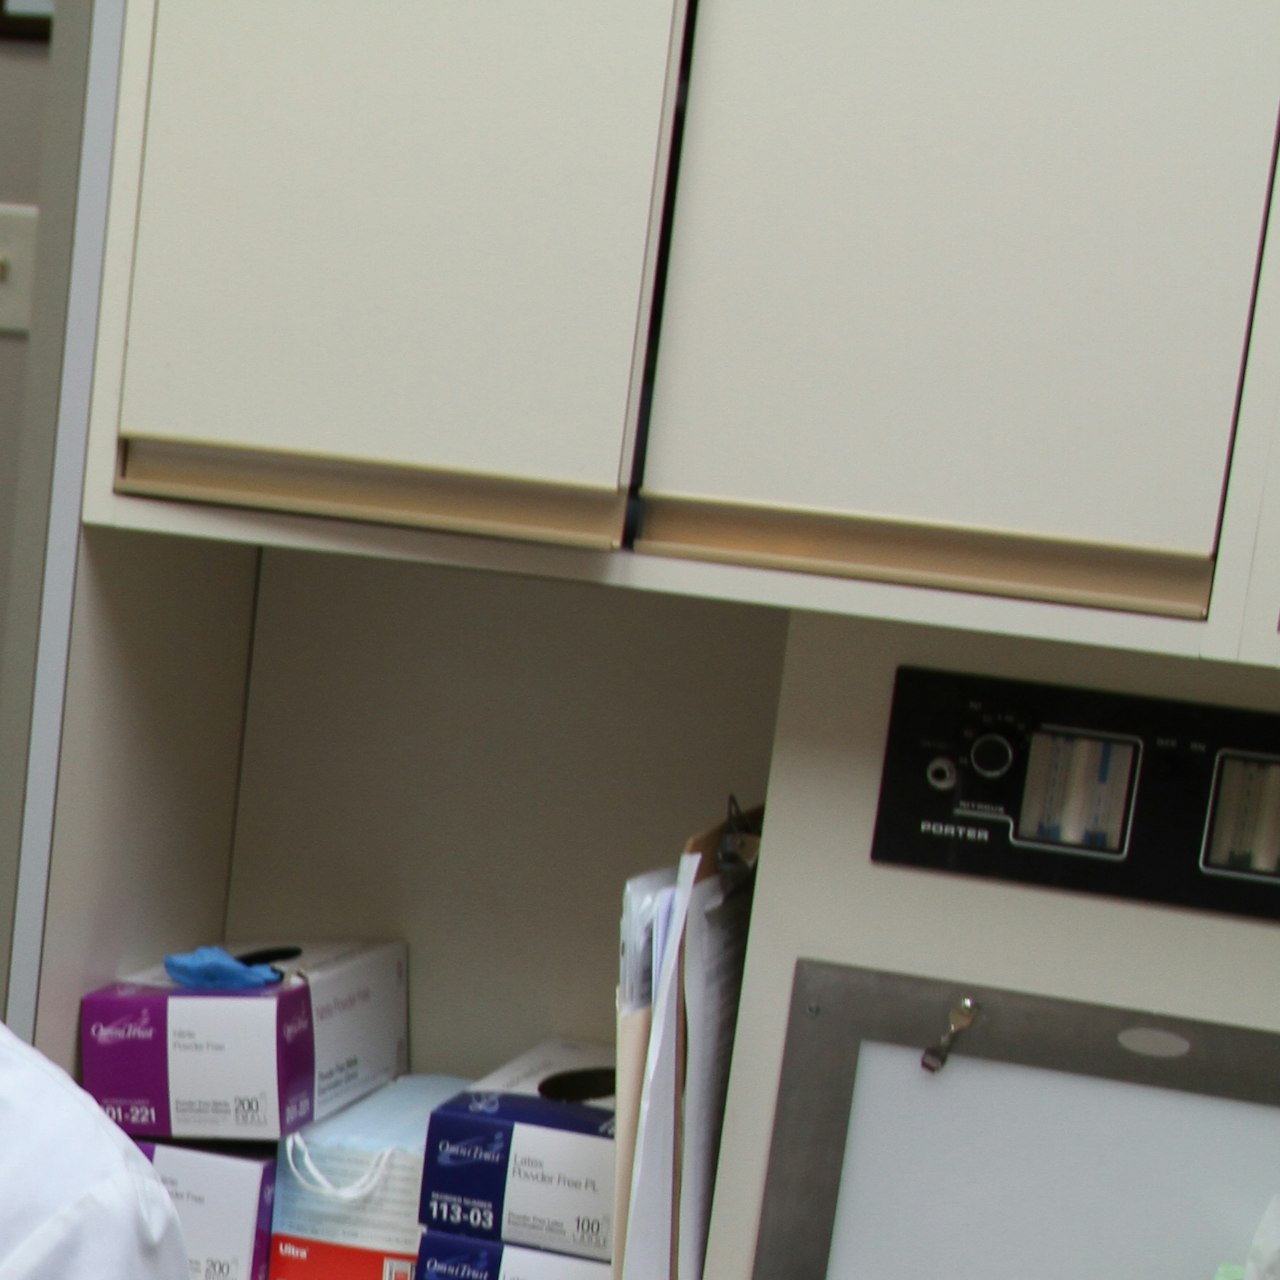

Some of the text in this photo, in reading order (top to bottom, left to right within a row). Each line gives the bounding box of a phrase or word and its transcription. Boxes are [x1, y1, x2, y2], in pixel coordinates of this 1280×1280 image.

[920, 820, 990, 842] PORTER
[234, 1096, 259, 1112] 200
[100, 1105, 156, 1124] 01-221
[438, 1140, 501, 1164] OmniTrust
[513, 1153, 544, 1168] Latex
[511, 1167, 554, 1184] Powder
[556, 1174, 582, 1190] Free
[429, 1201, 494, 1229] 113-03
[575, 1215, 600, 1235] 100
[279, 1242, 308, 1260] Ultra
[205, 1257, 231, 1277] 200
